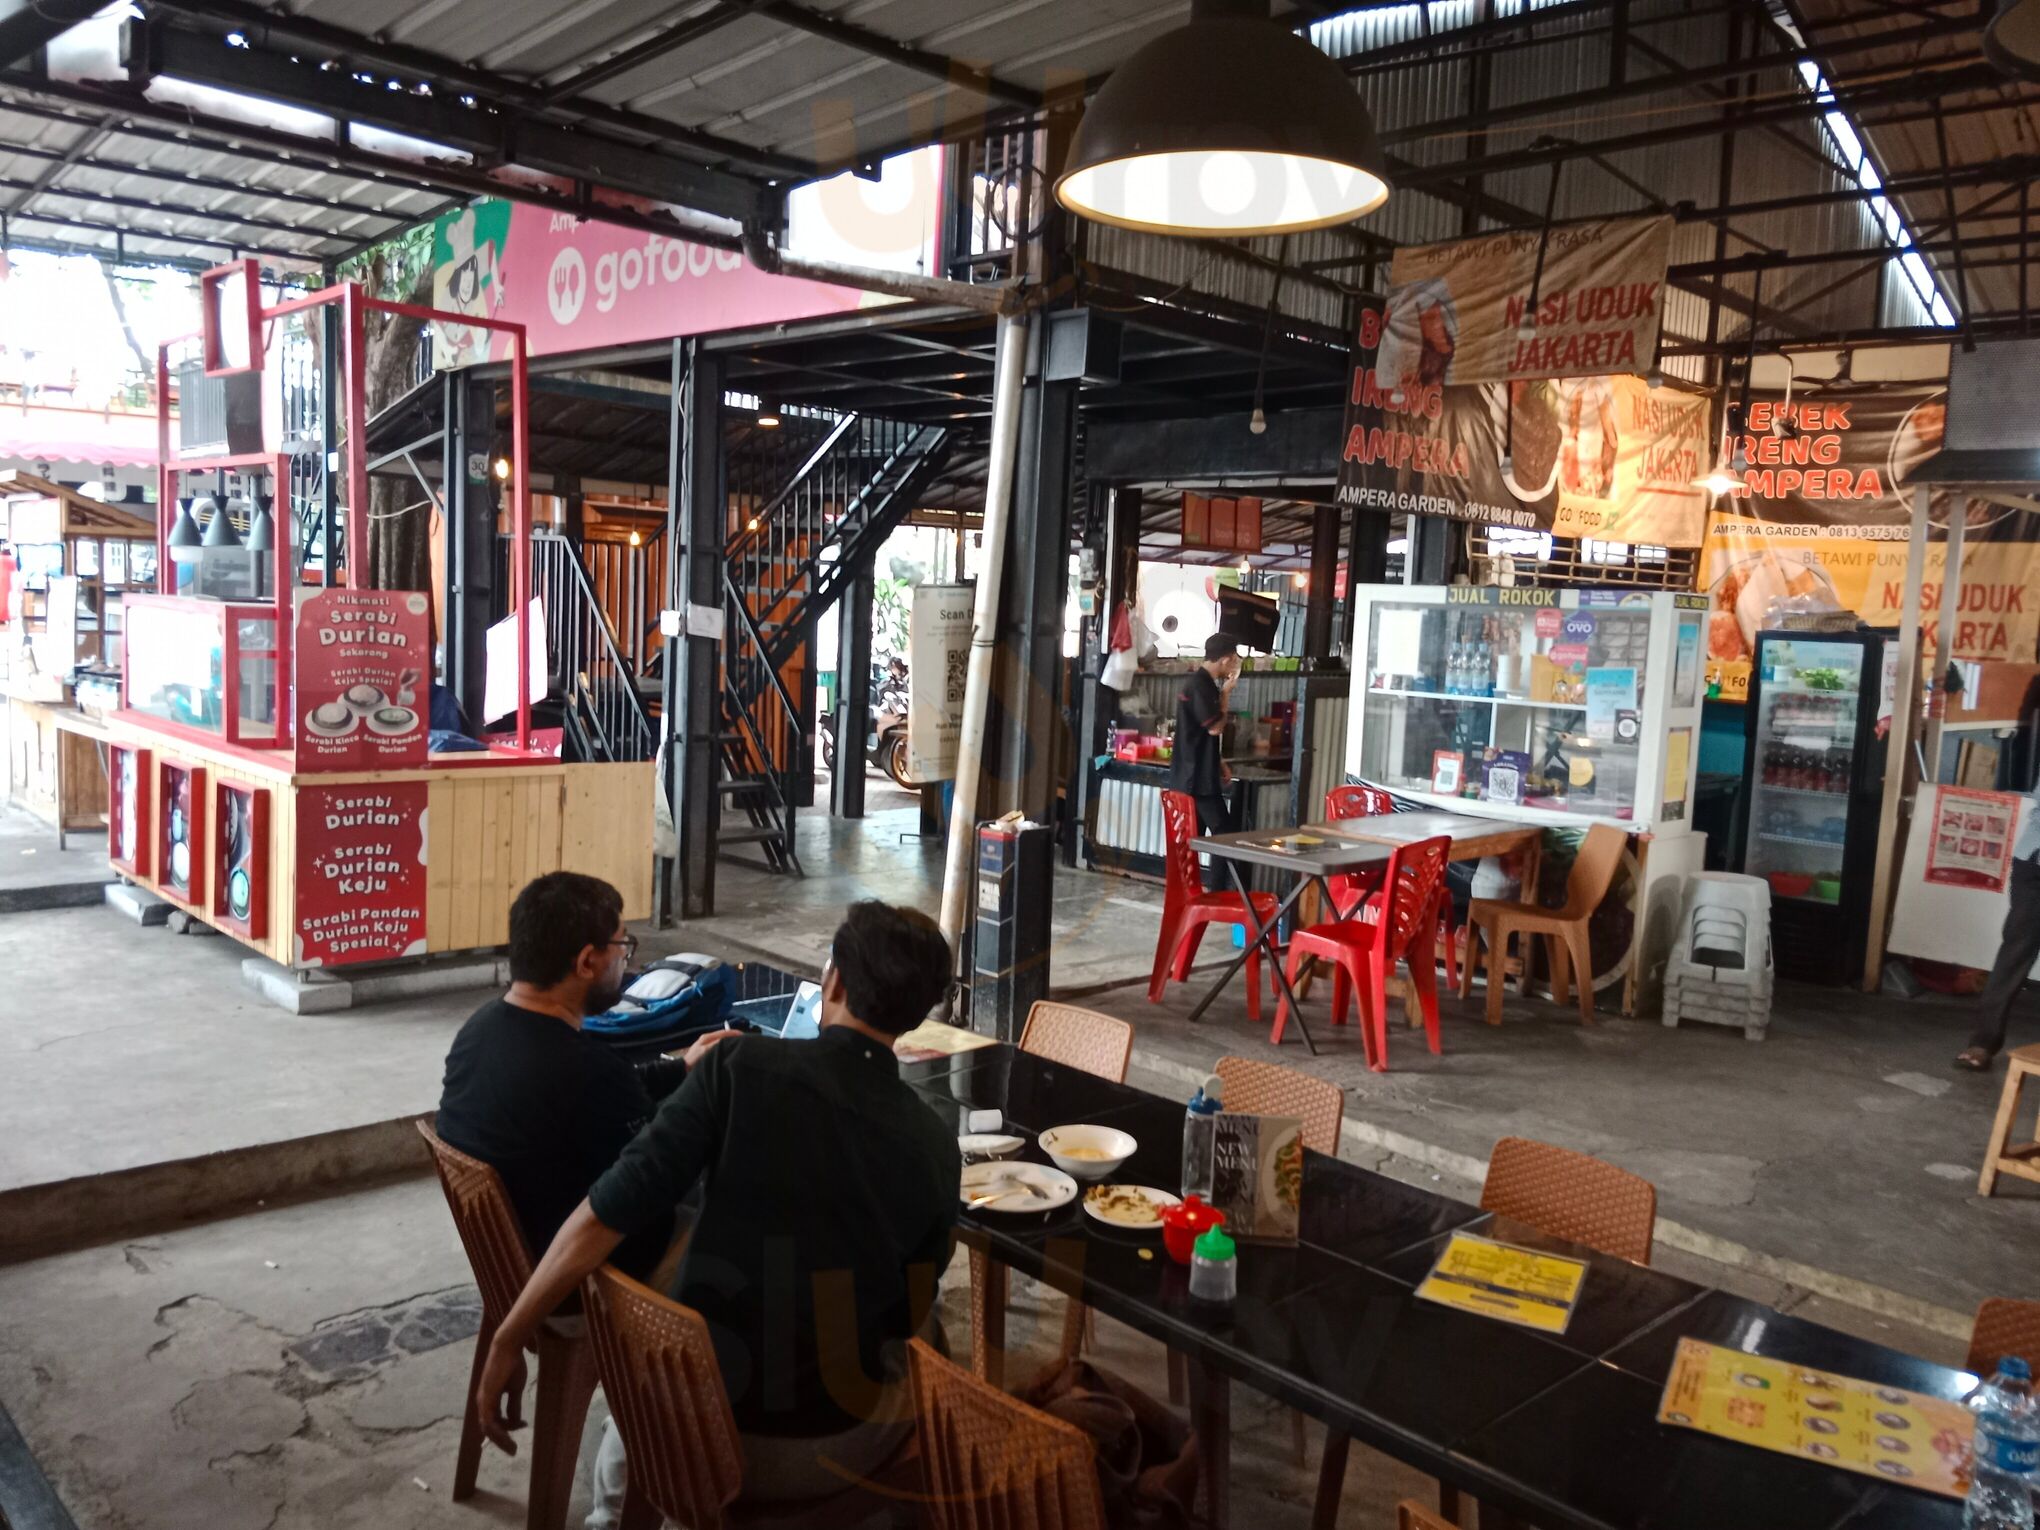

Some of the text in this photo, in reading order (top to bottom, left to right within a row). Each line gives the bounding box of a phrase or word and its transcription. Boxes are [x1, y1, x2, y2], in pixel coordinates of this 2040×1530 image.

[1491, 233, 1551, 257] PUNY
[1556, 230, 1603, 249] RASA
[1576, 281, 1659, 324] UDUK
[1507, 329, 1636, 373] JAKARTA
[1632, 394, 1664, 434] NASI
[1343, 423, 1471, 480] AMPERA
[1636, 445, 1699, 484] JAKARTA
[1337, 485, 1396, 509] AMPERA
[1398, 494, 1456, 515] GARDEN
[1559, 507, 1601, 526] GO FOOD
[1766, 525, 1818, 537] GARDEN
[1829, 527, 1857, 538] 0813
[1862, 527, 1891, 539] 9575
[1802, 551, 1861, 566] BETAWI
[1867, 552, 1911, 567] PUNY
[337, 595, 390, 606] Nikmati
[1448, 588, 1555, 607] JUAL ROKOK
[1882, 581, 1943, 611] NSI
[330, 609, 397, 626] Serabi
[939, 609, 965, 621] Scan
[319, 625, 408, 648] Durian
[1566, 622, 1593, 634] OVO
[339, 647, 388, 660] Sekarang
[335, 795, 392, 811] Serabi
[325, 808, 401, 830] Durian
[334, 843, 392, 860] Serabi
[324, 857, 401, 879] Durian
[338, 875, 387, 895] Keju
[302, 906, 420, 930] Serabi Pandan
[313, 920, 408, 943] Durian Keju
[330, 935, 389, 954] Spesial
